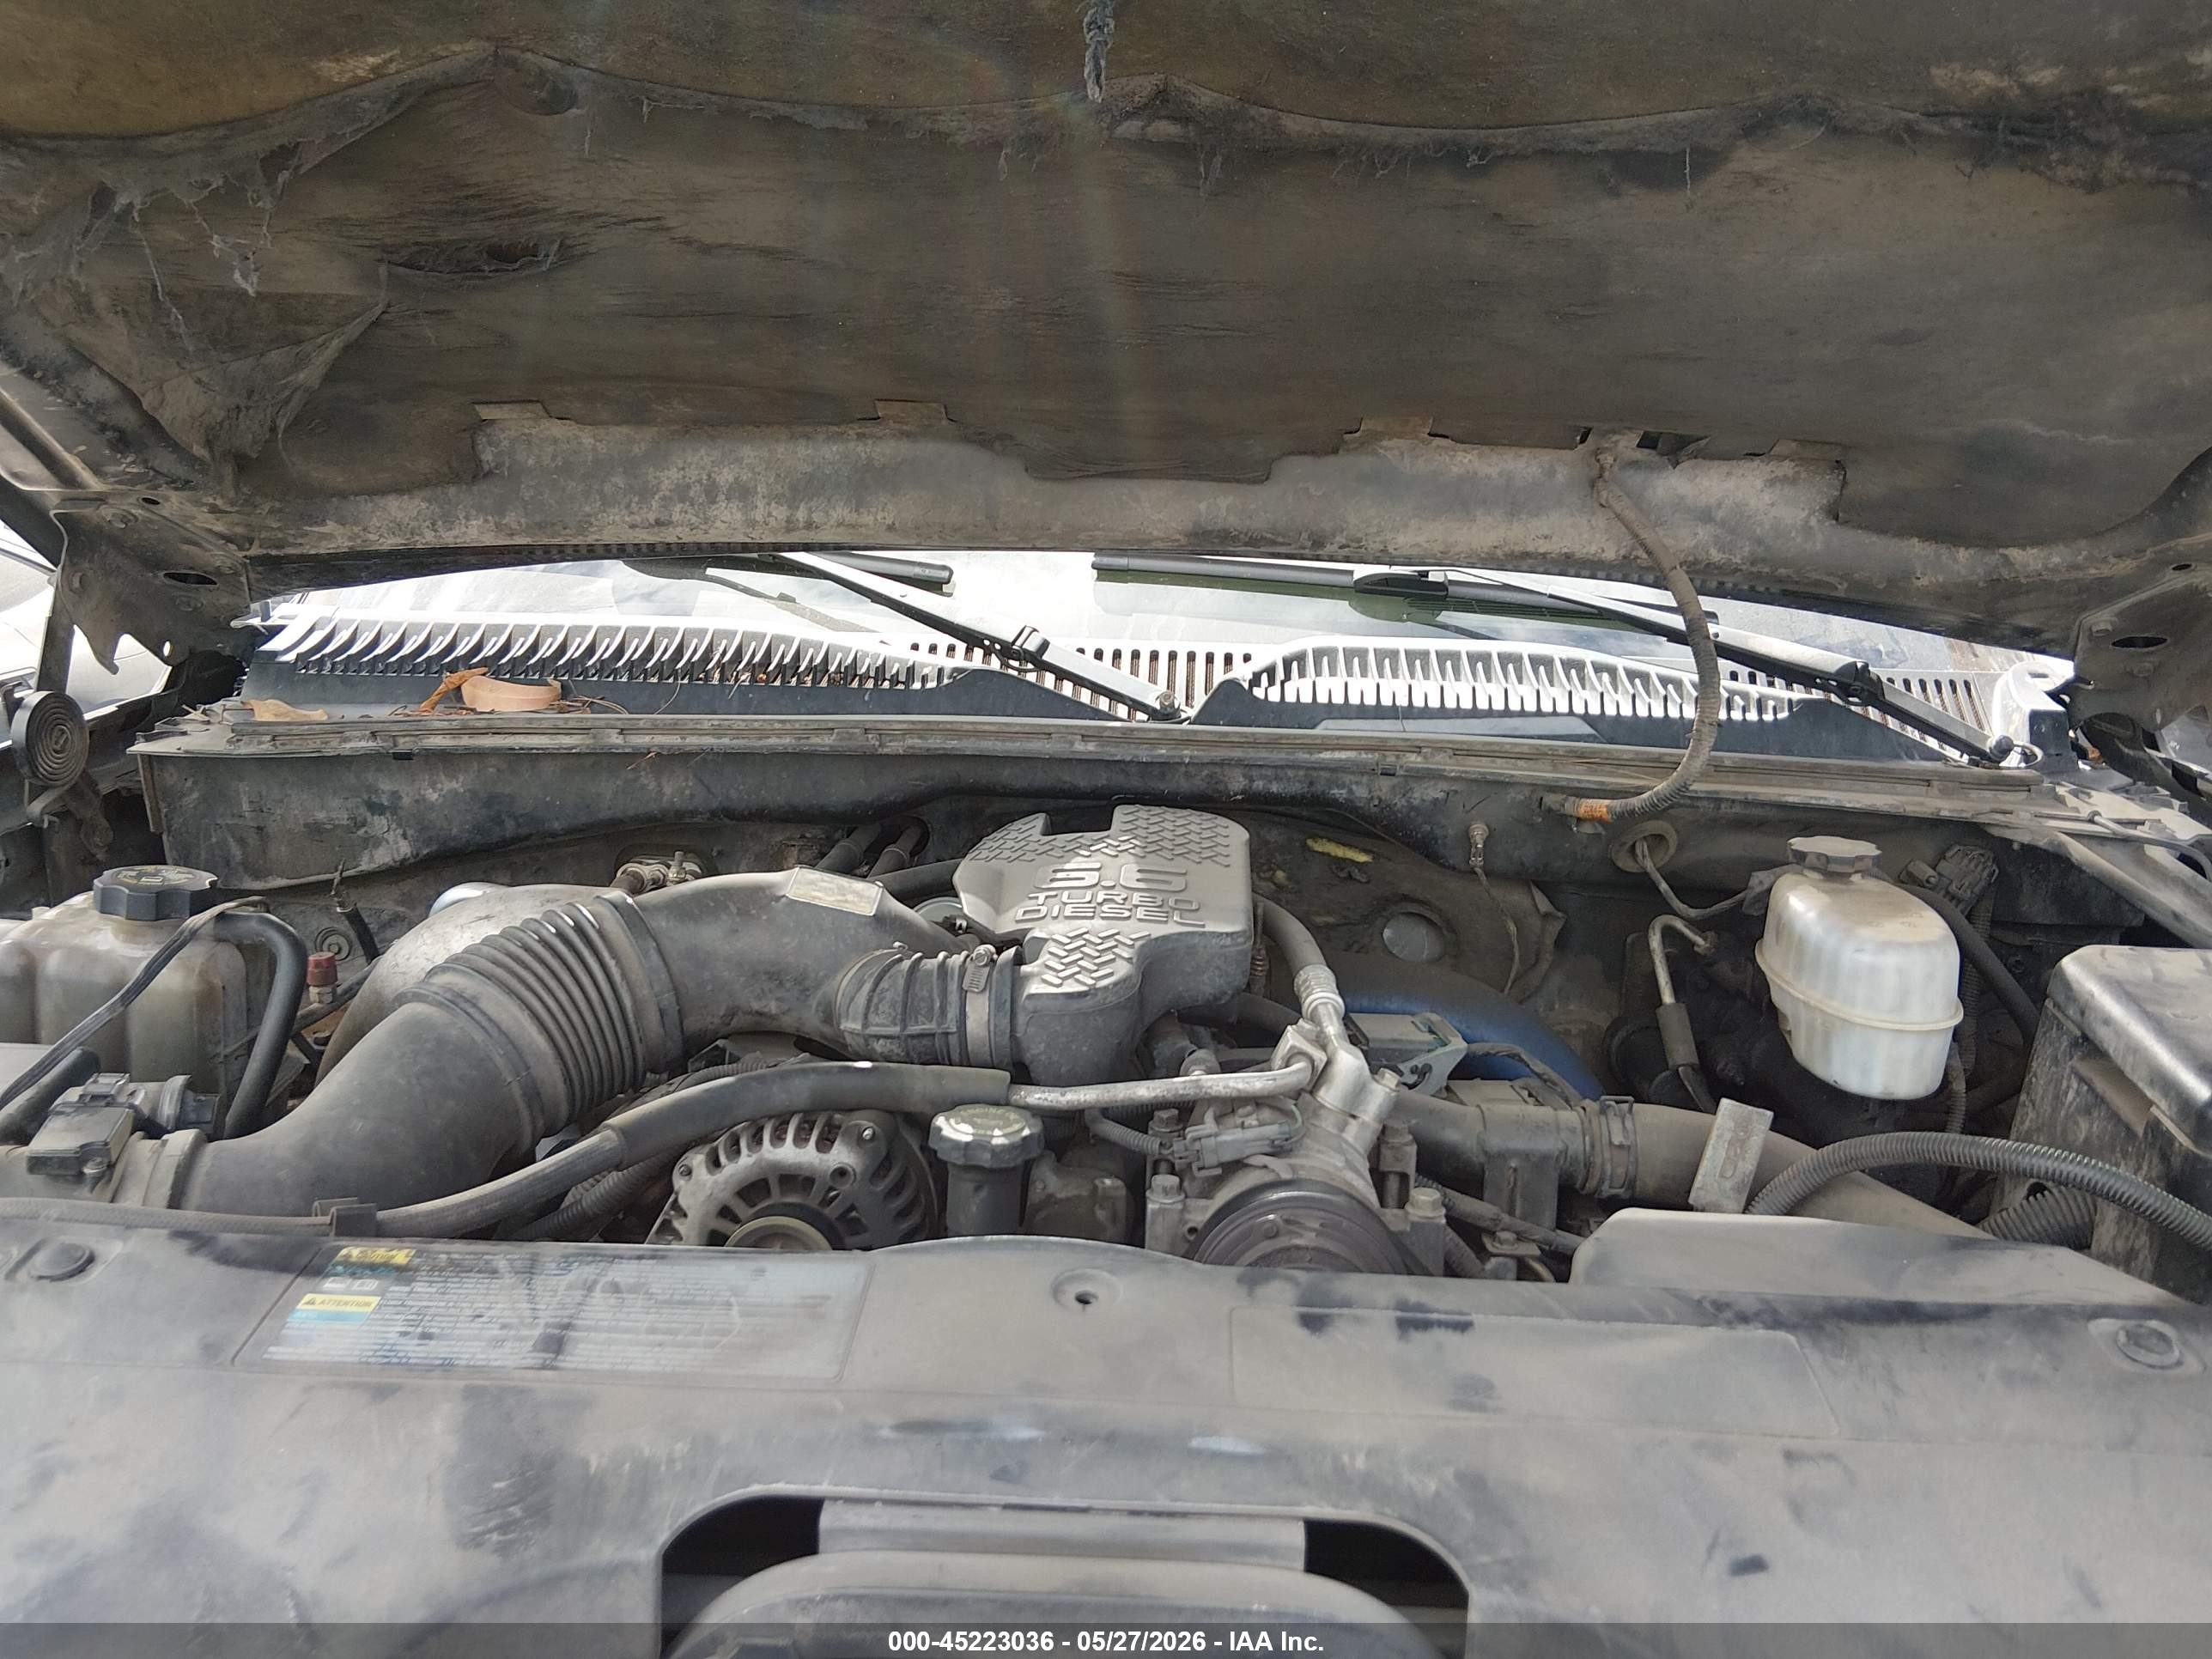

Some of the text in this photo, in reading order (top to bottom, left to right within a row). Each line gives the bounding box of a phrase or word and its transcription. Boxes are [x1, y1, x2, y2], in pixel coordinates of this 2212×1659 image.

[1027, 890, 1201, 911] TURBO
[1014, 902, 1206, 929] DIESEL
[318, 1297, 374, 1308] ATTENTION
